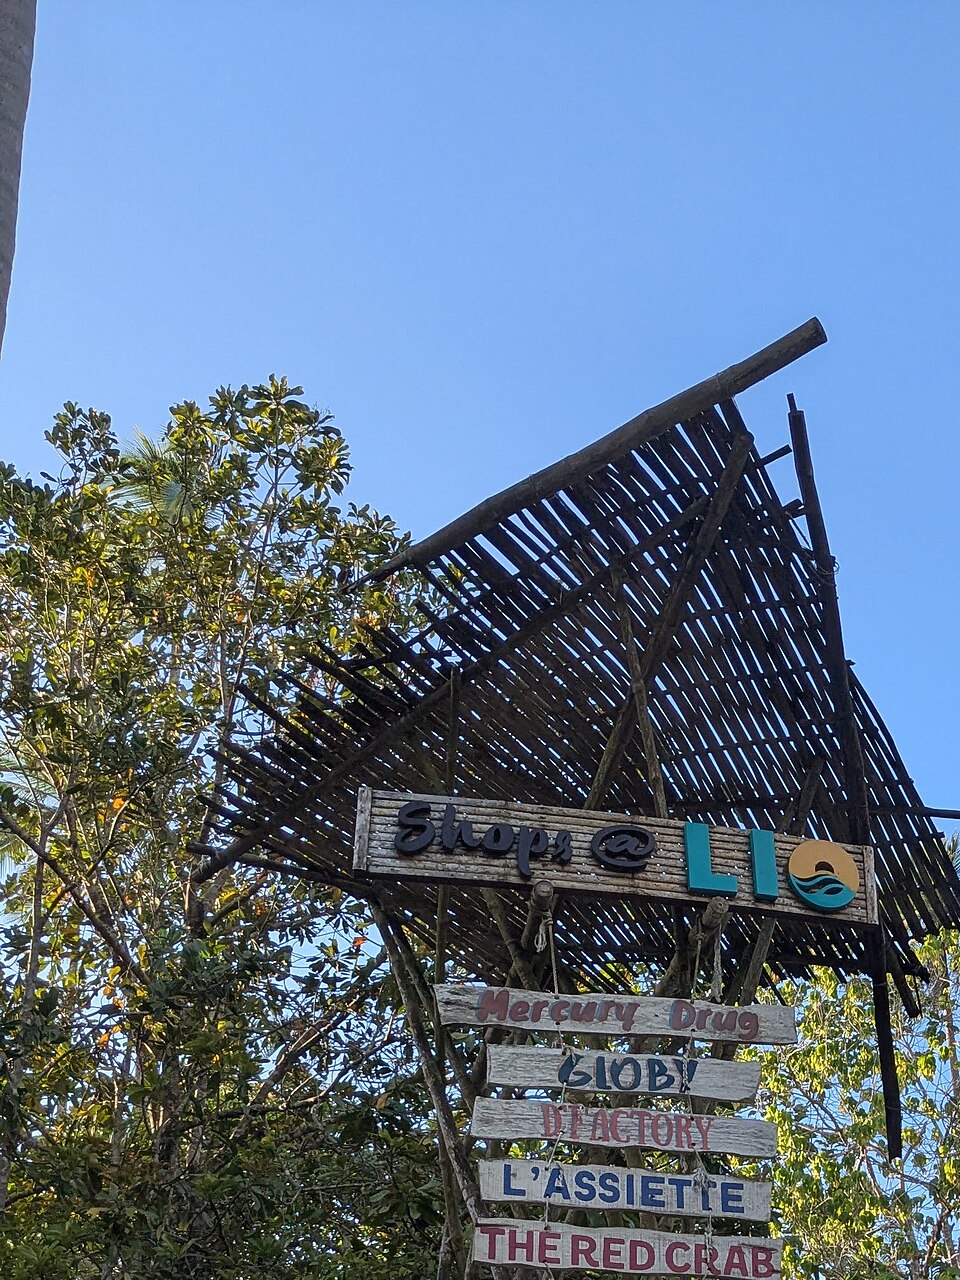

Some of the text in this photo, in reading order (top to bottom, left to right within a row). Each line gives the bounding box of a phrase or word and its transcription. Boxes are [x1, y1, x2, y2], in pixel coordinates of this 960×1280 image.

[394, 800, 860, 912] Shops @ LIO
[476, 989, 760, 1040] Mercury Drug
[503, 1163, 745, 1214] L'ASSIETTE
[479, 1226, 775, 1278] THE RED CRAB
